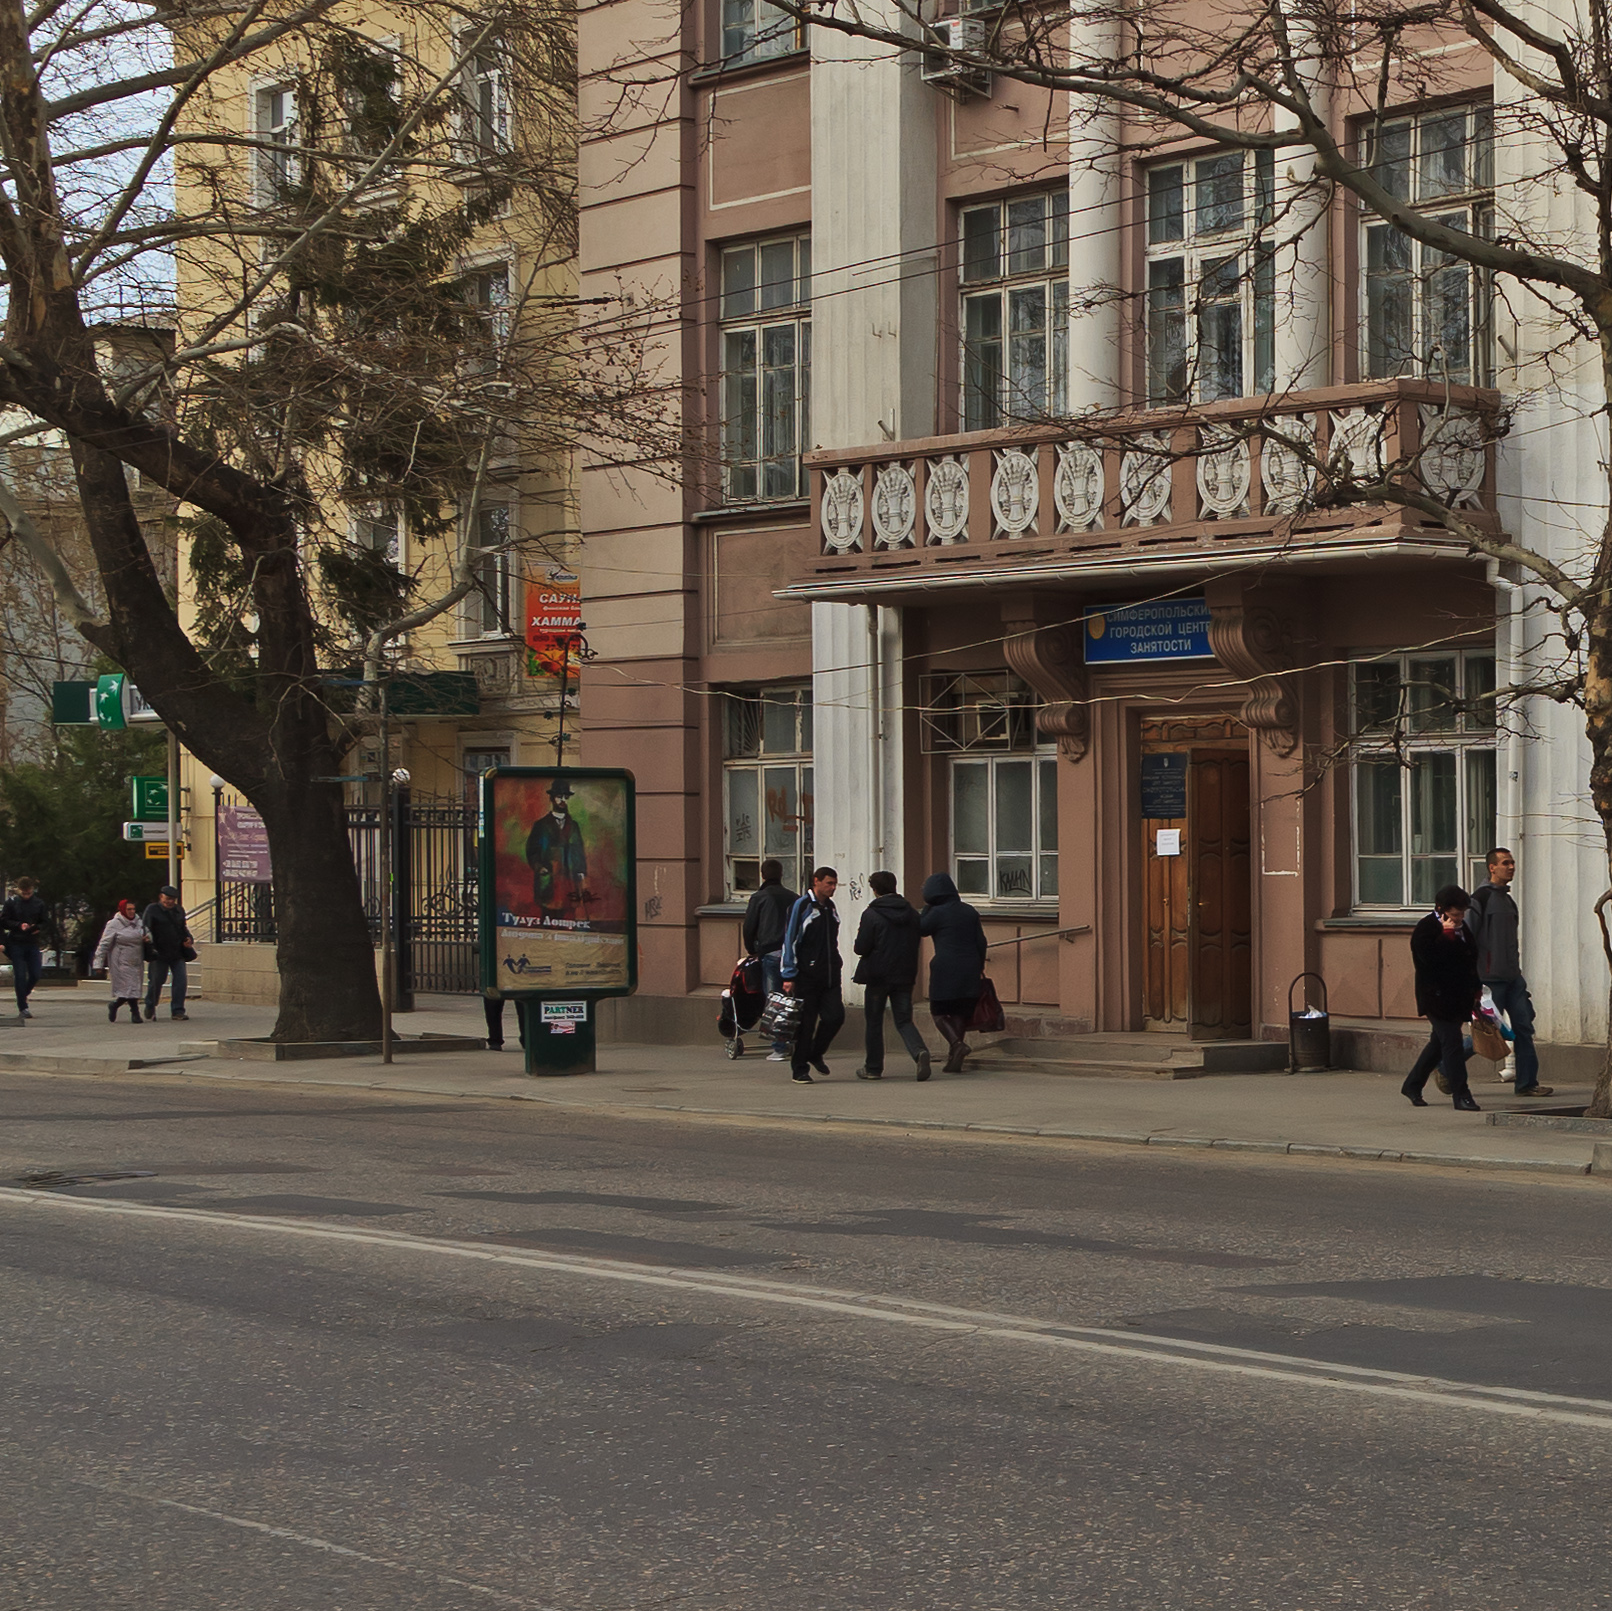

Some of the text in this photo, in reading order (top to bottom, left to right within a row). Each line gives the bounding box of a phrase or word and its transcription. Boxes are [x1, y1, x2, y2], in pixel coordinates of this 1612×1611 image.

[1110, 622, 1172, 639] ГОРОДСКОЙ
[1130, 639, 1192, 654] ЗАНЯТОСТИ
[544, 1006, 584, 1015] PARTNER
